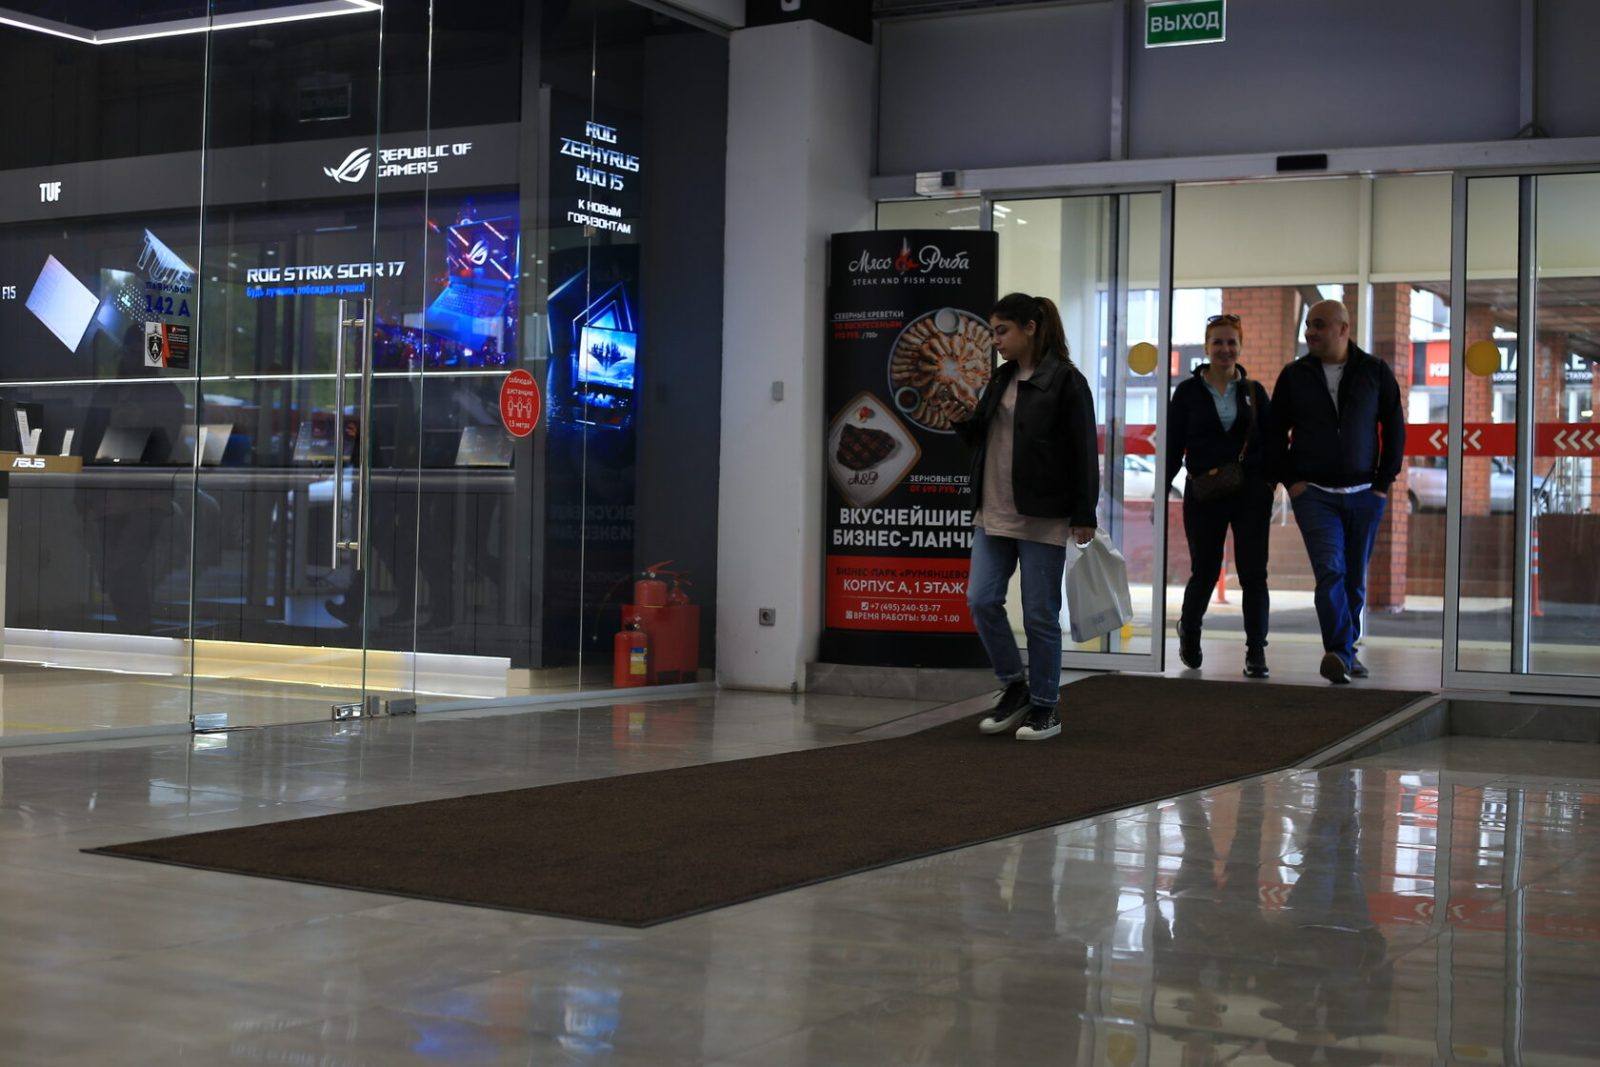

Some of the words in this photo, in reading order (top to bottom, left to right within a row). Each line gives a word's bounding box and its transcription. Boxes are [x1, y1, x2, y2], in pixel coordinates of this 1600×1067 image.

[1150, 11, 1220, 33] ВЫХОД
[378, 145, 449, 164] REPUBLIC
[452, 142, 472, 156] OF
[560, 137, 640, 172] ZEPHYRUS
[377, 161, 438, 177] GAMERS
[576, 165, 606, 187] DUO
[609, 173, 624, 191] 15
[39, 182, 61, 202] TUF
[578, 199, 585, 210] К
[587, 201, 622, 217] НОВЫМ
[567, 211, 631, 234] ГОРИЗОНТАМ
[848, 250, 892, 273] Мясо
[919, 245, 970, 273] Рыба
[246, 267, 281, 283] ROG
[284, 265, 334, 281] STRIX
[337, 263, 384, 278] SCAR
[388, 261, 406, 277] 17
[852, 278, 878, 286] STEAK
[881, 277, 900, 285] AND
[930, 277, 962, 285] HOUSE
[2, 286, 17, 300] F15
[145, 295, 174, 316] 142
[12, 457, 46, 469] ASUS
[910, 474, 952, 483] ЗЕРНОВЫЕ
[953, 475, 971, 483] СТЕ
[839, 505, 972, 526] ВКУСНЕЙШИЕ
[843, 579, 895, 592] КОРПУС
[897, 581, 912, 595] А,
[914, 581, 919, 592] 1
[923, 581, 965, 594] ЭТАЖ
[854, 611, 880, 620] ВРЕМЯ
[881, 611, 919, 621] РАБОТЫ:
[921, 614, 938, 622] 9.00
[944, 615, 960, 623] 1.00
[880, 603, 900, 612] (495)
[901, 604, 941, 612] 240-53-77
